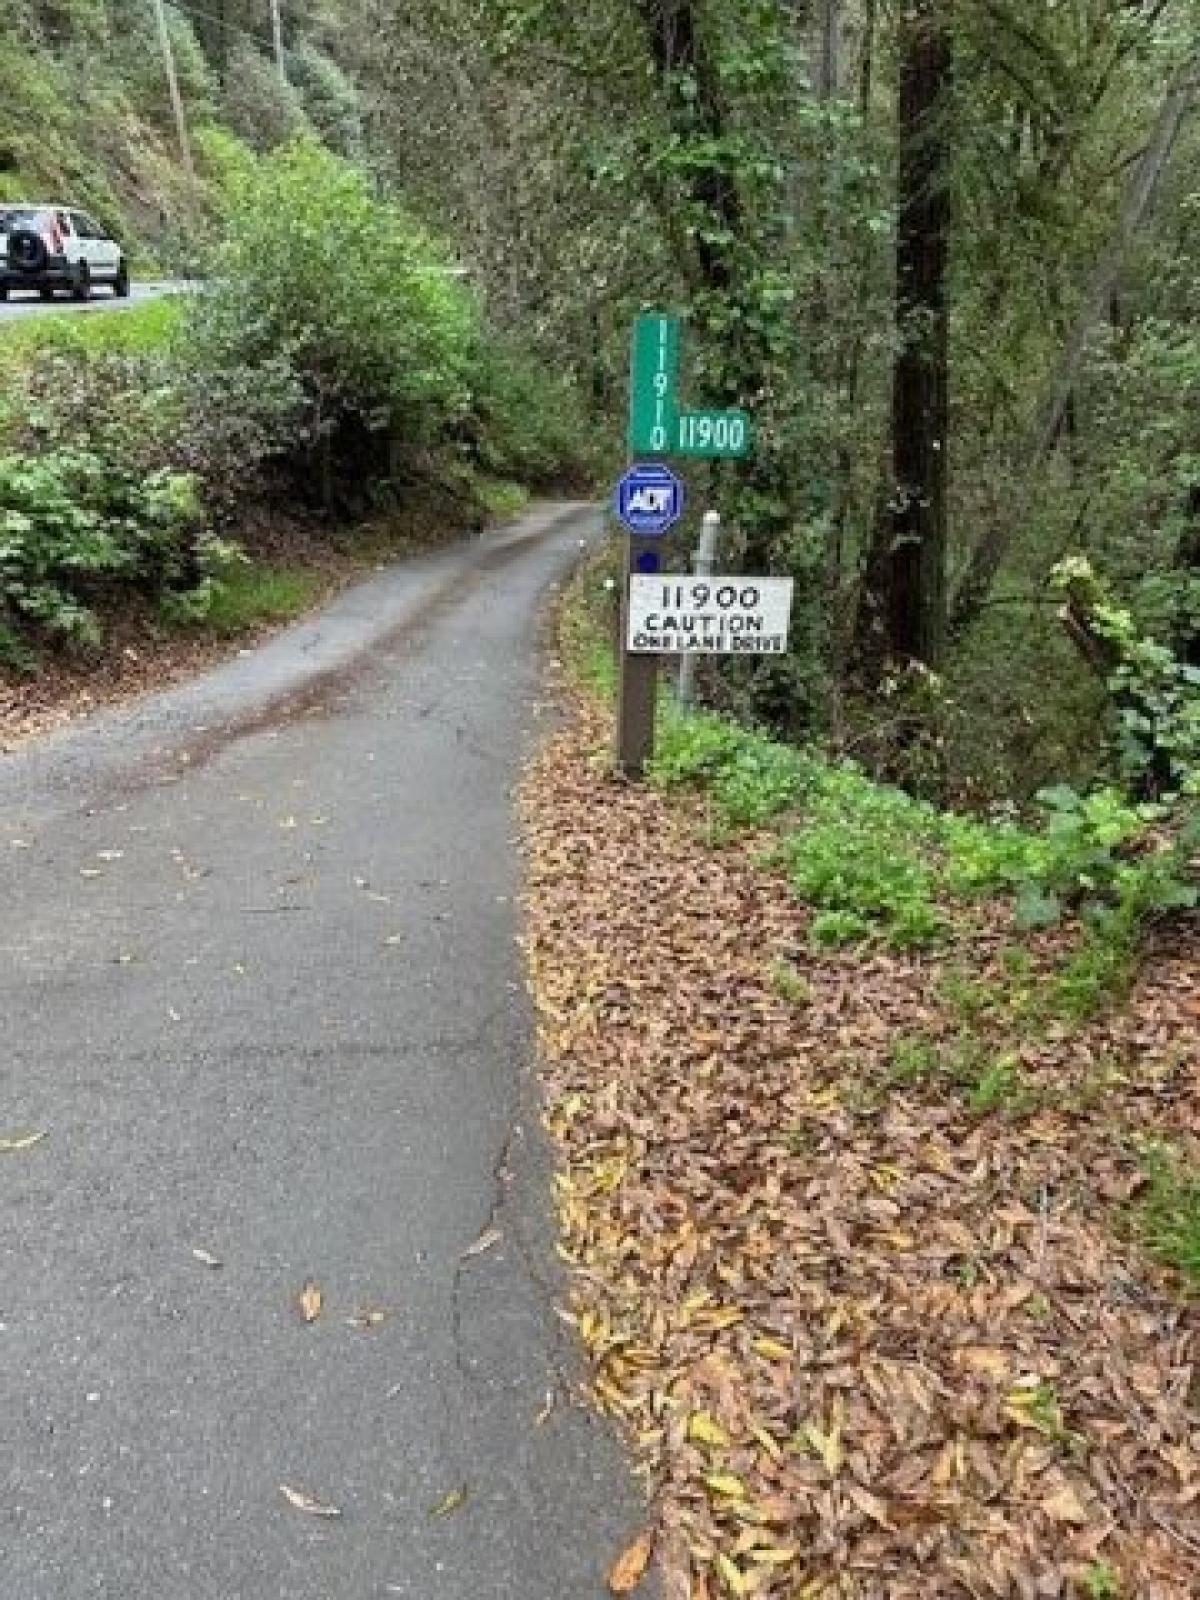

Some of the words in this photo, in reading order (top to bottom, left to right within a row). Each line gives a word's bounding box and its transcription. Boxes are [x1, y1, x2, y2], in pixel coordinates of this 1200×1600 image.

[649, 319, 668, 450] 11910
[679, 416, 744, 450] 11900
[662, 583, 760, 609] 11900
[644, 613, 763, 632] CAUTION
[632, 633, 672, 647] ONE
[676, 635, 721, 649] LANE
